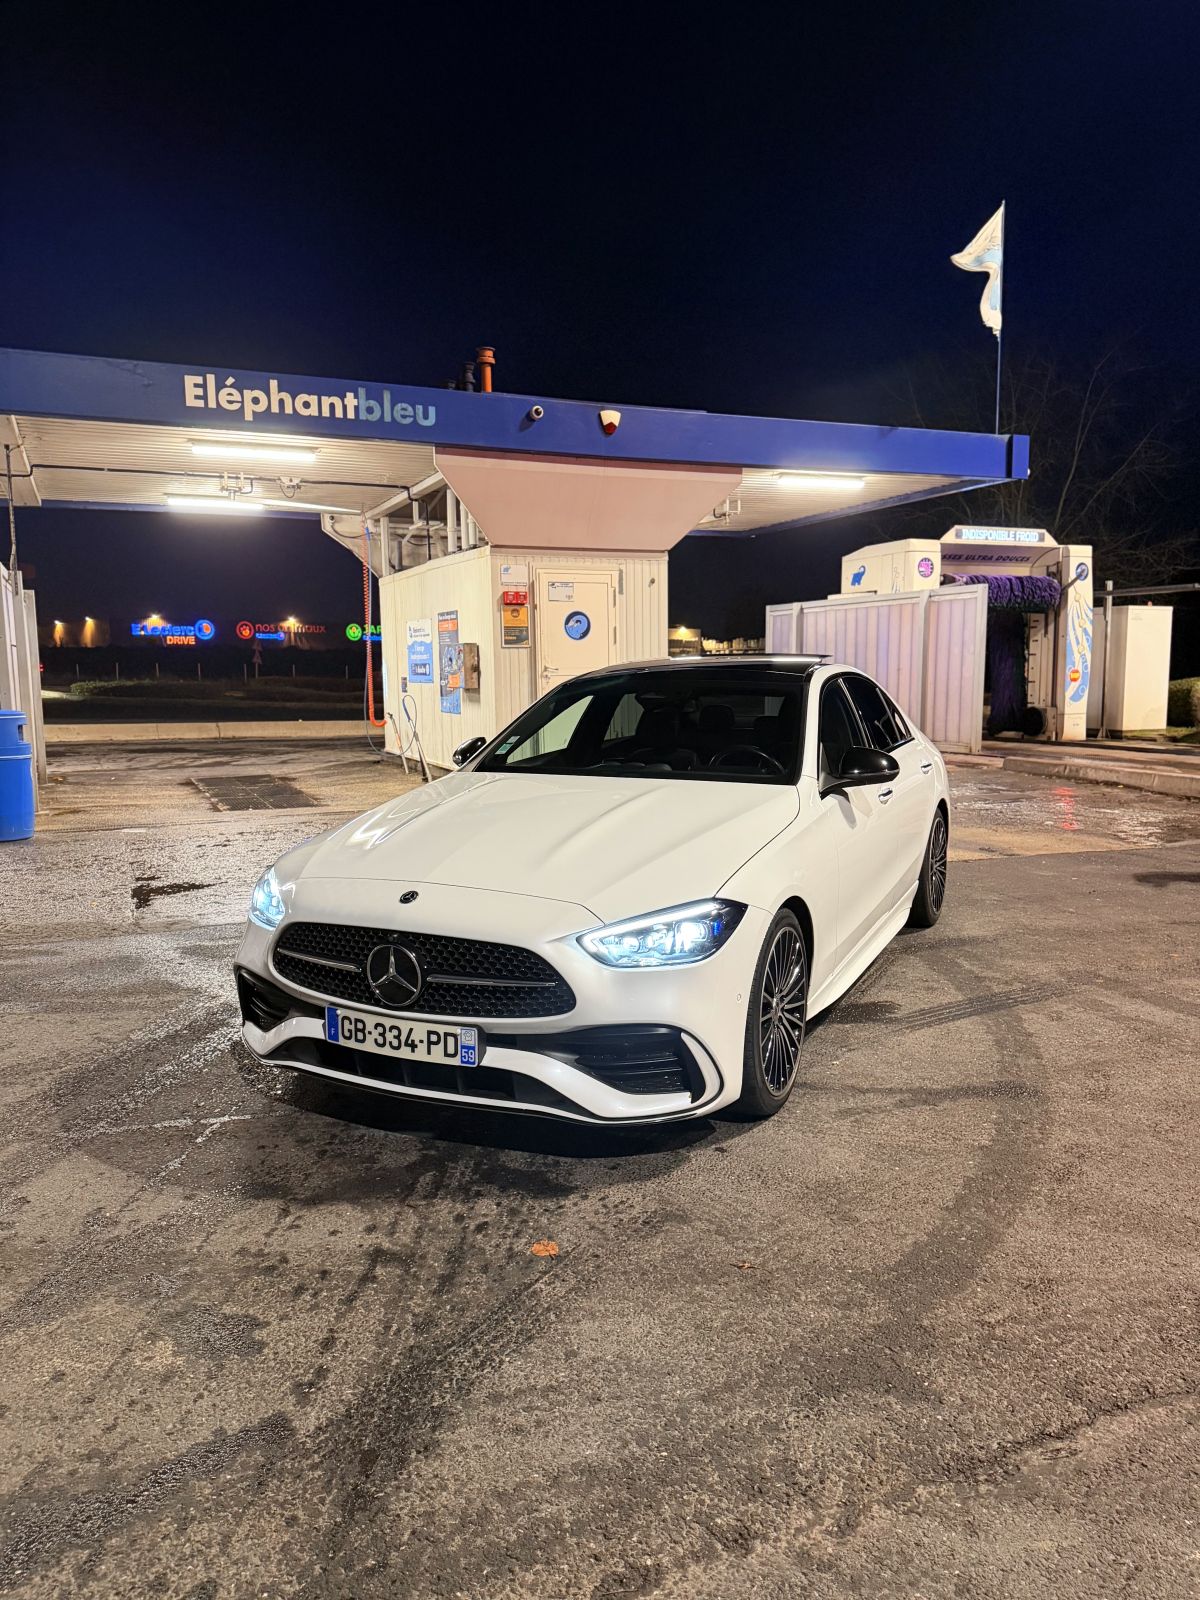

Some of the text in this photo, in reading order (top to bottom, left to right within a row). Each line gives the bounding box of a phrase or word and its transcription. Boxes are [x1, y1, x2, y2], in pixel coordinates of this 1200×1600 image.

[961, 528, 1039, 542] INDISPONIBLE FROID
[255, 624, 275, 632] nos
[166, 635, 196, 645] DRIVE
[340, 1015, 459, 1059] GB-334-PD
[461, 1049, 475, 1063] 59
